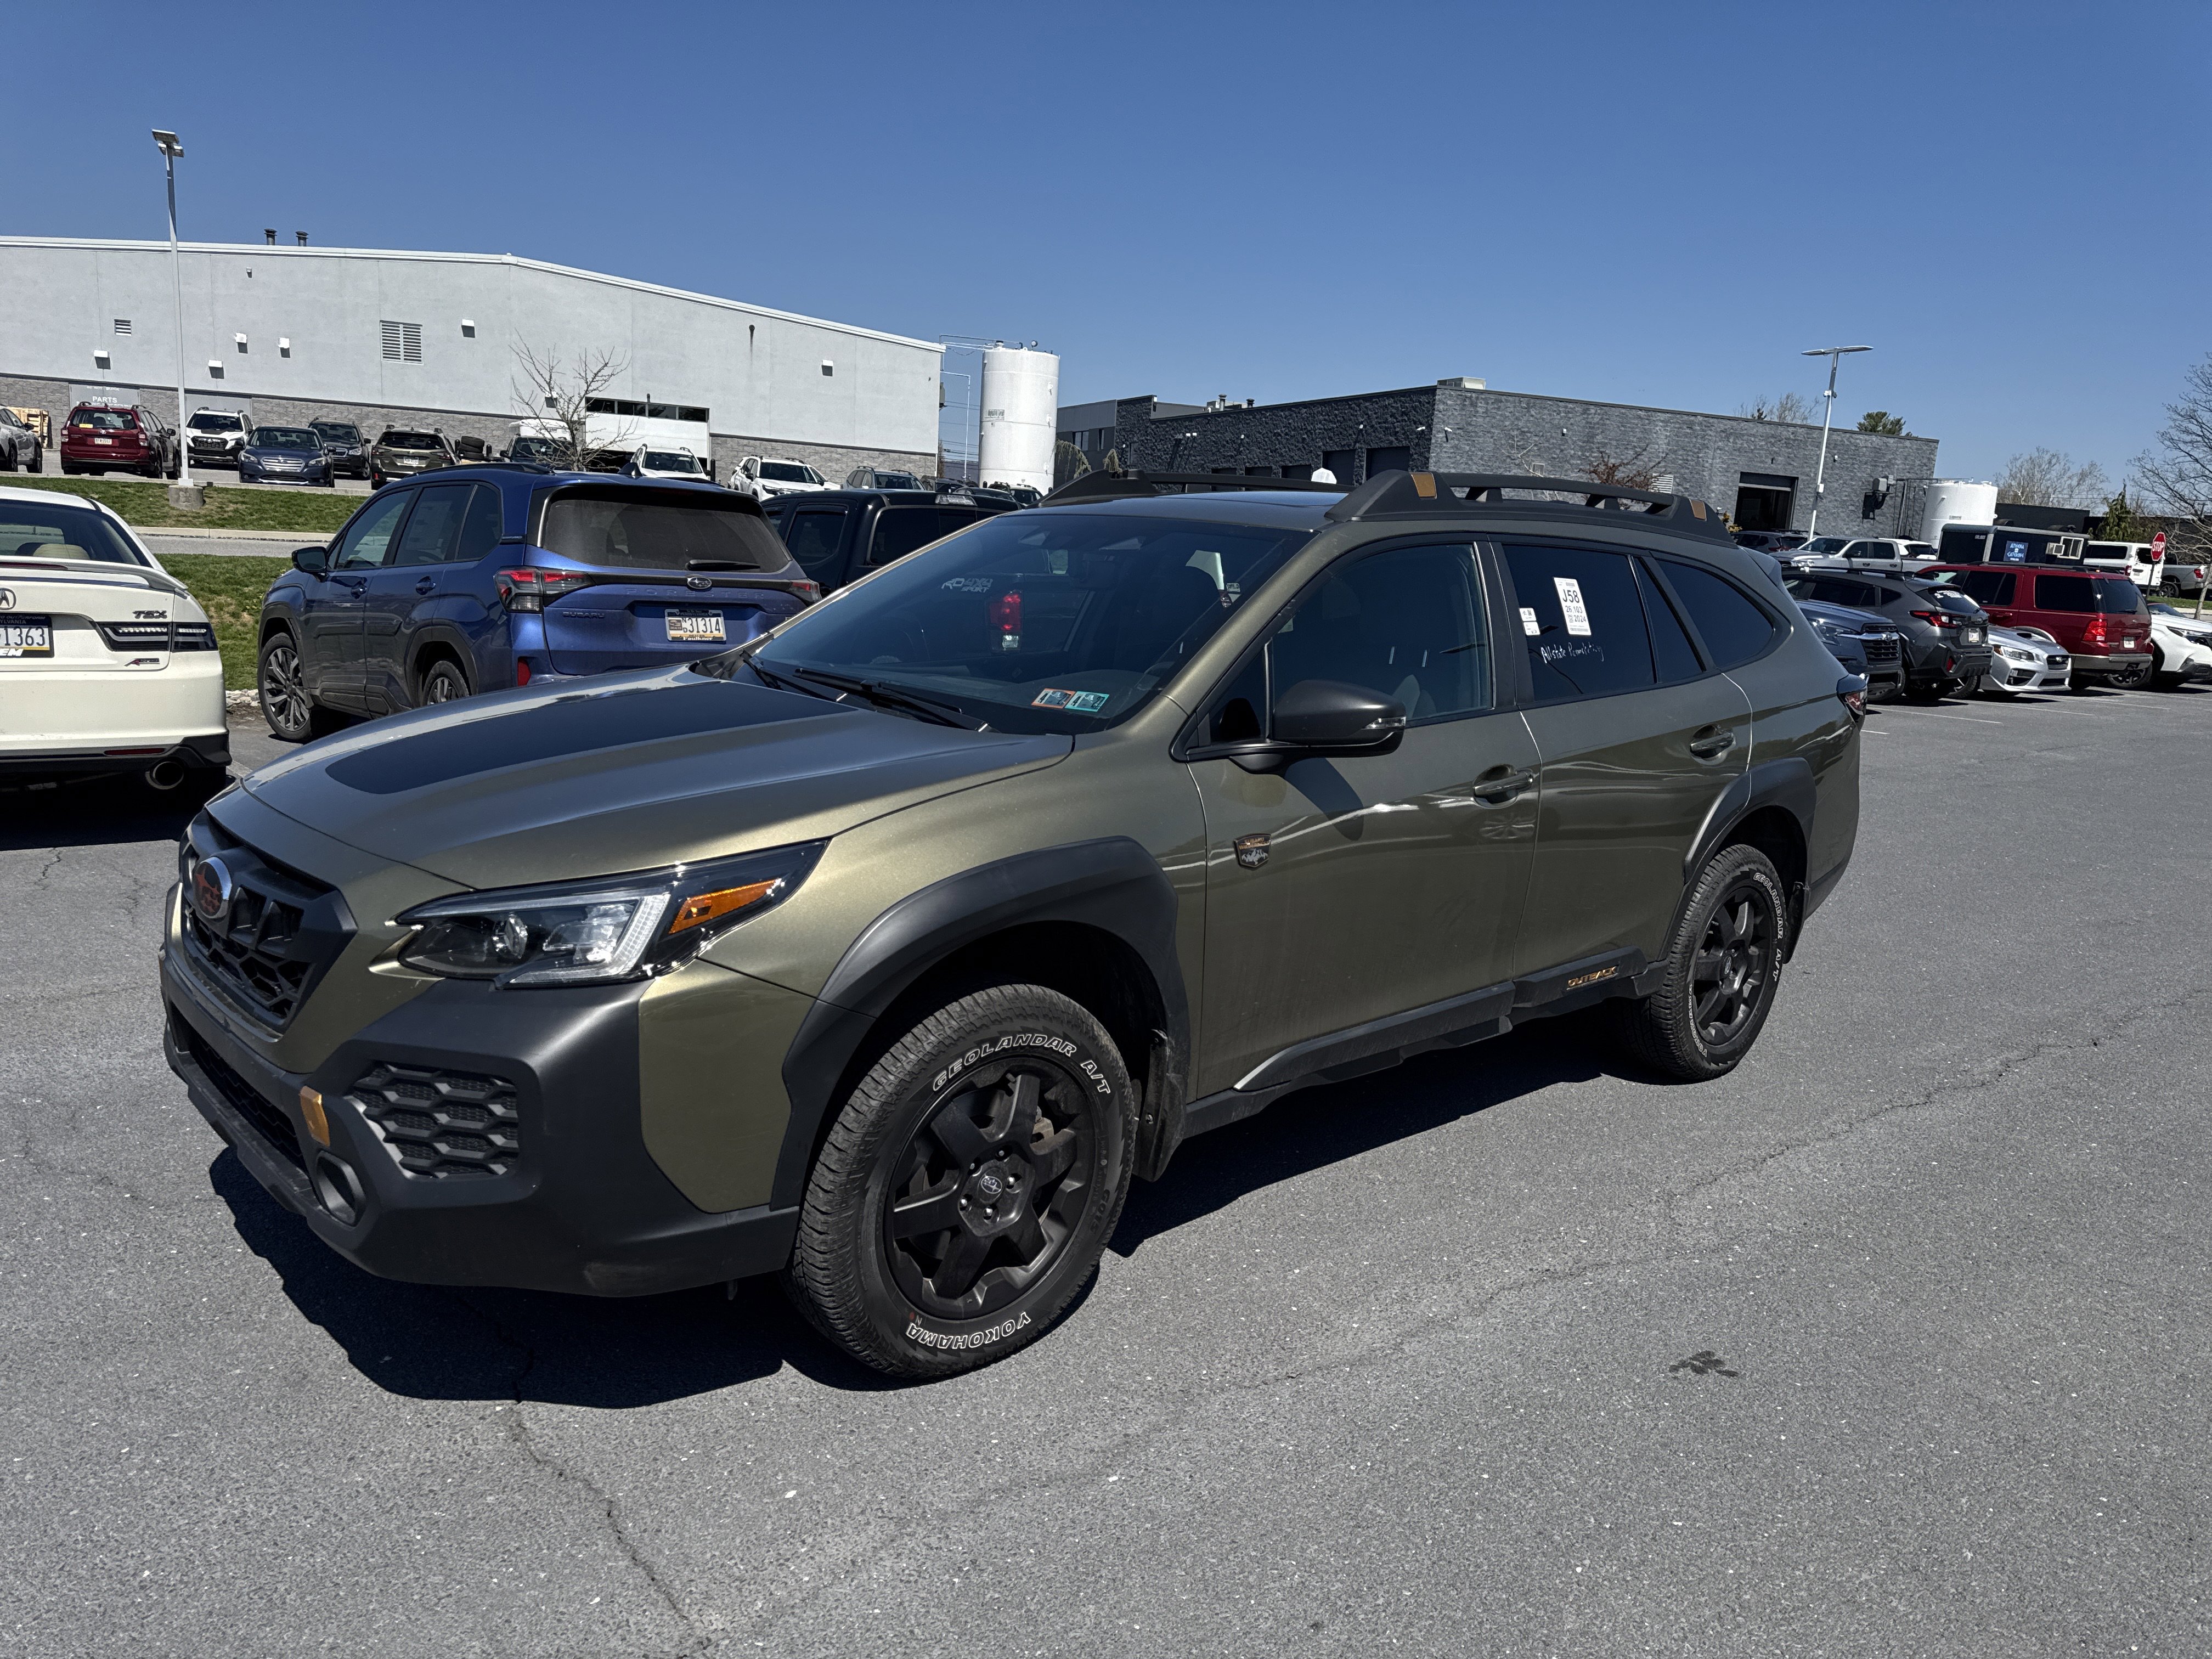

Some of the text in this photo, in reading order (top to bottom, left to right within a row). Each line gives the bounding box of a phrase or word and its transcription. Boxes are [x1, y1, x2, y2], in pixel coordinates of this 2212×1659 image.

[2152, 541, 2165, 552] STOP
[625, 588, 765, 600] FORESTER
[1562, 589, 1580, 603] J58
[132, 610, 167, 619] TSX
[562, 611, 605, 619] SUBARU
[1753, 872, 1785, 982] GEOLANDAR A/T
[933, 1034, 1111, 1095] GEOLANDAR A/T
[905, 1311, 1032, 1350] YOKOHAMA
